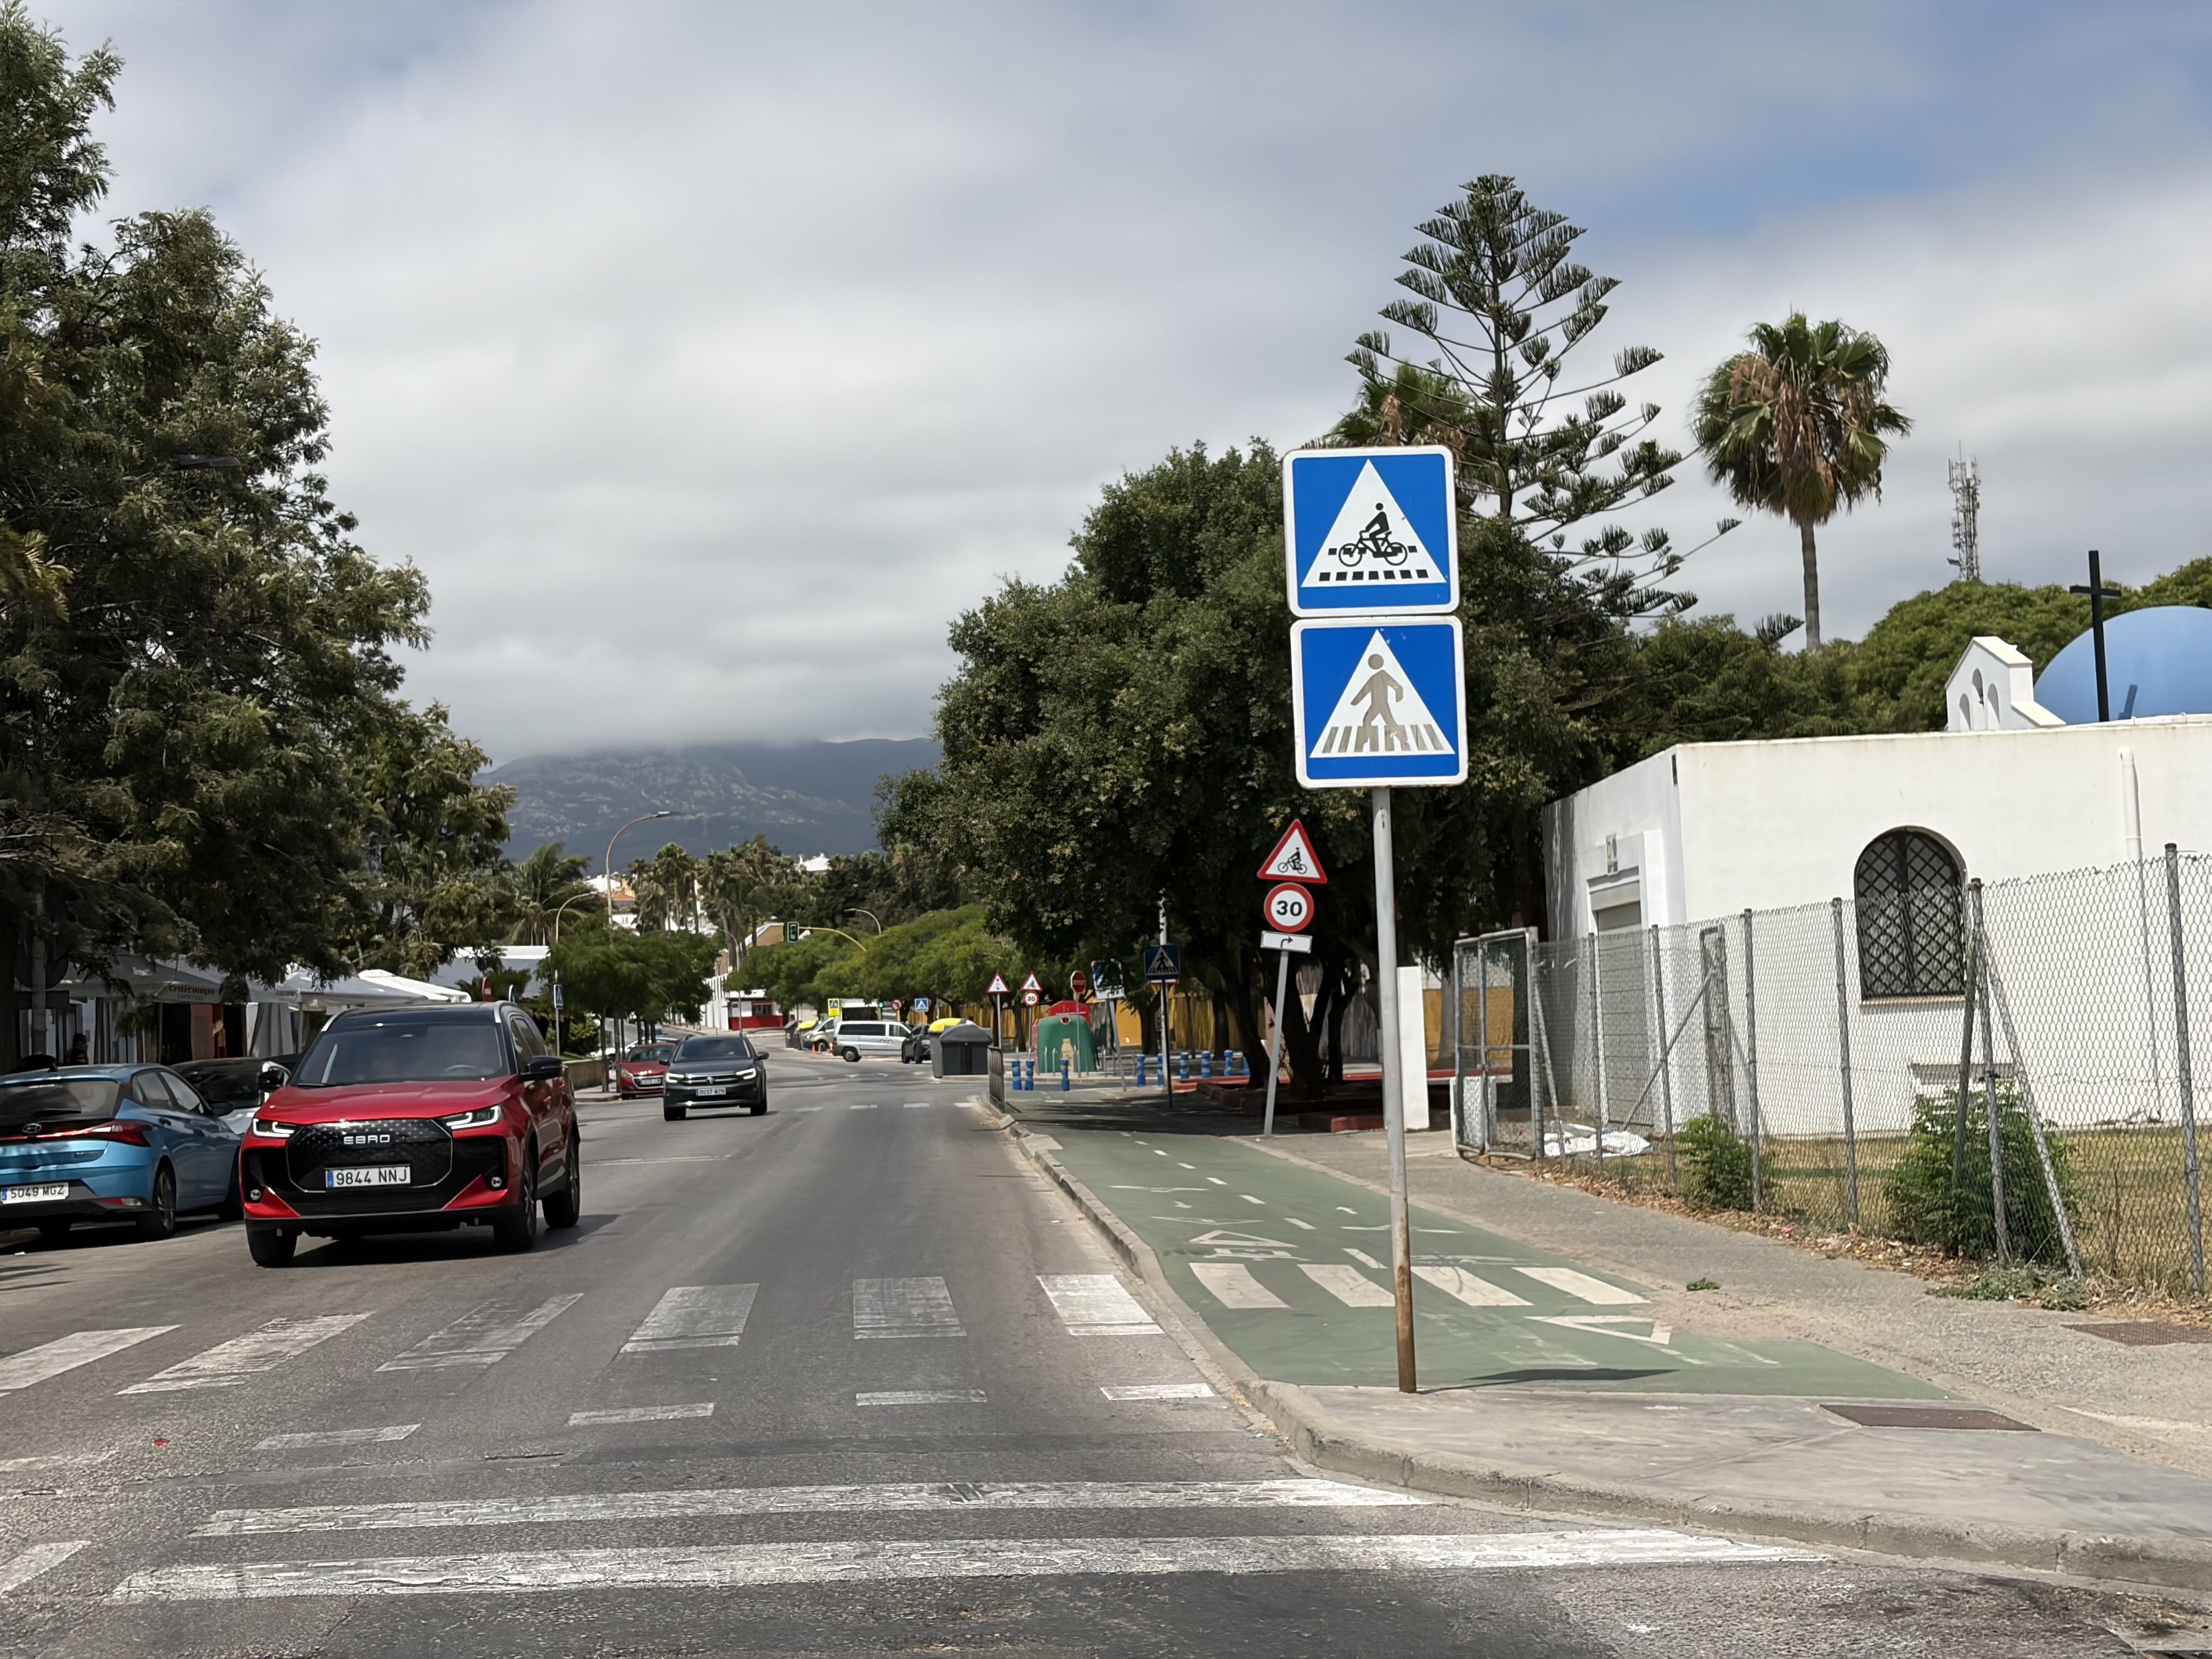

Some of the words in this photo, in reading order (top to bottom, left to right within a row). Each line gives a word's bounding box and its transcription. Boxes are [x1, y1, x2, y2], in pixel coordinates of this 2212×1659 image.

[1276, 900, 1302, 916] 30
[336, 1171, 372, 1185] 9844
[379, 1169, 407, 1183] NNJ
[11, 1186, 39, 1199] 5049
[42, 1184, 65, 1196] MGZ
